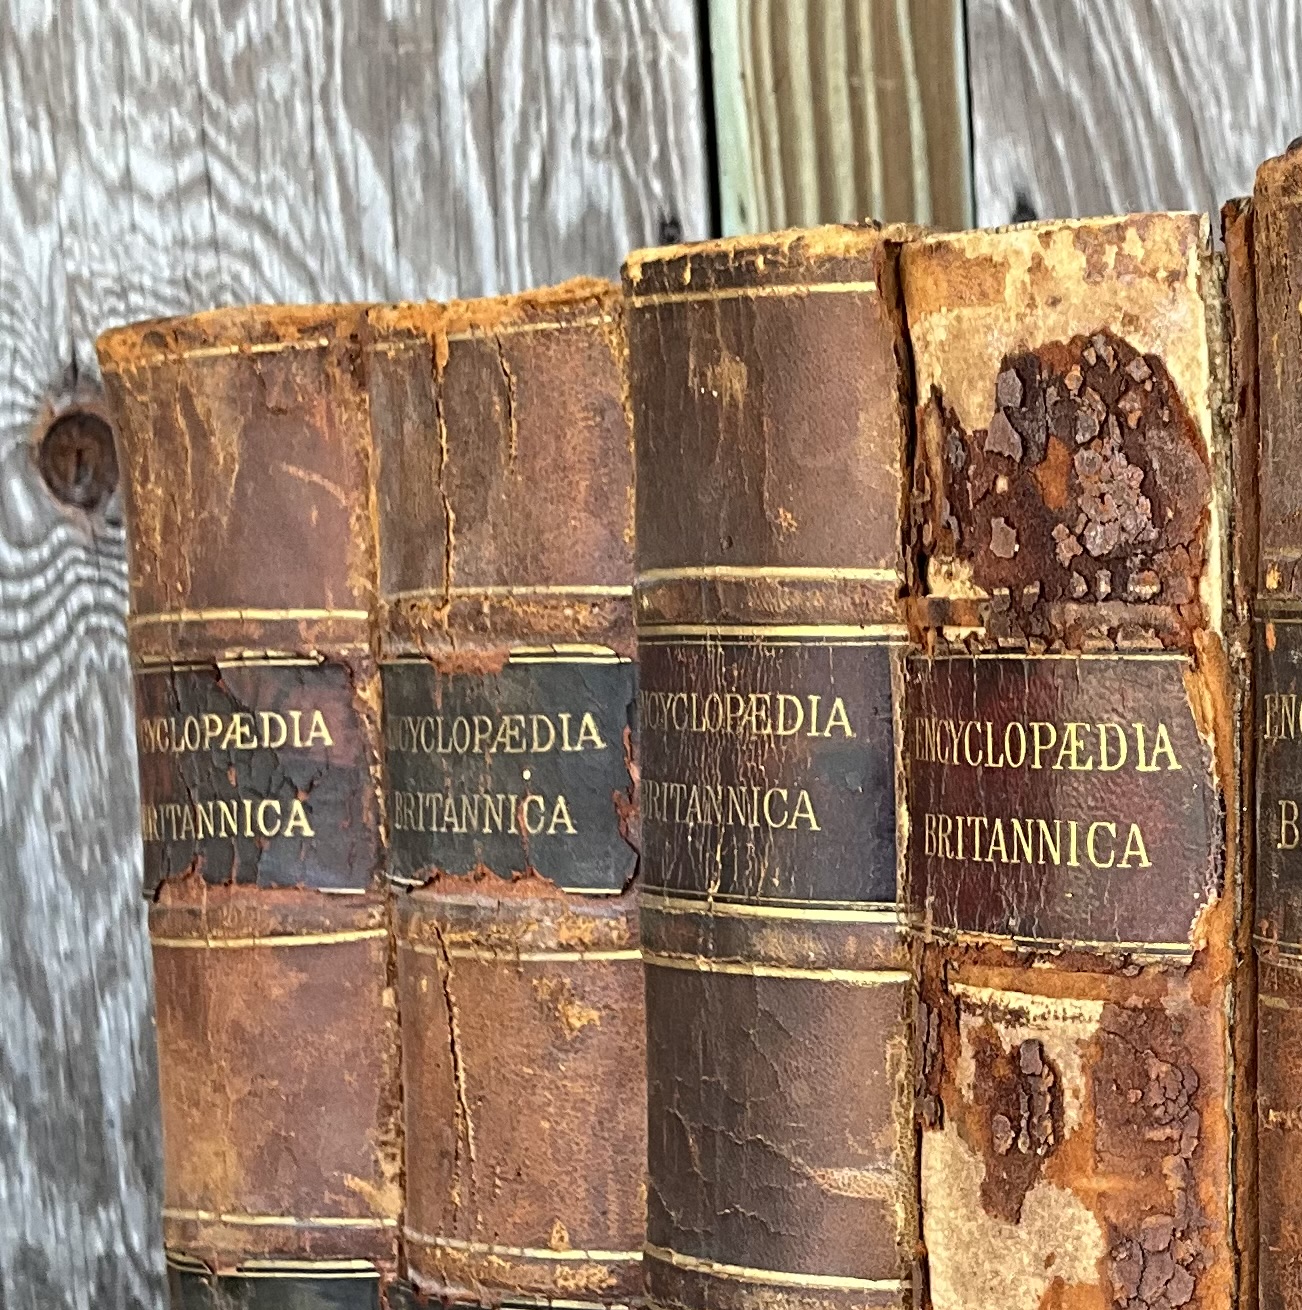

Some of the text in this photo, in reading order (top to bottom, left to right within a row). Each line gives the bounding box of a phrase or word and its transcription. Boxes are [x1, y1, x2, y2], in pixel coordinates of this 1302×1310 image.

[914, 716, 1183, 772] ENCYCLOPÆDIA
[394, 791, 578, 835] BRITANNICA
[924, 813, 1153, 869] BRITANNICA
